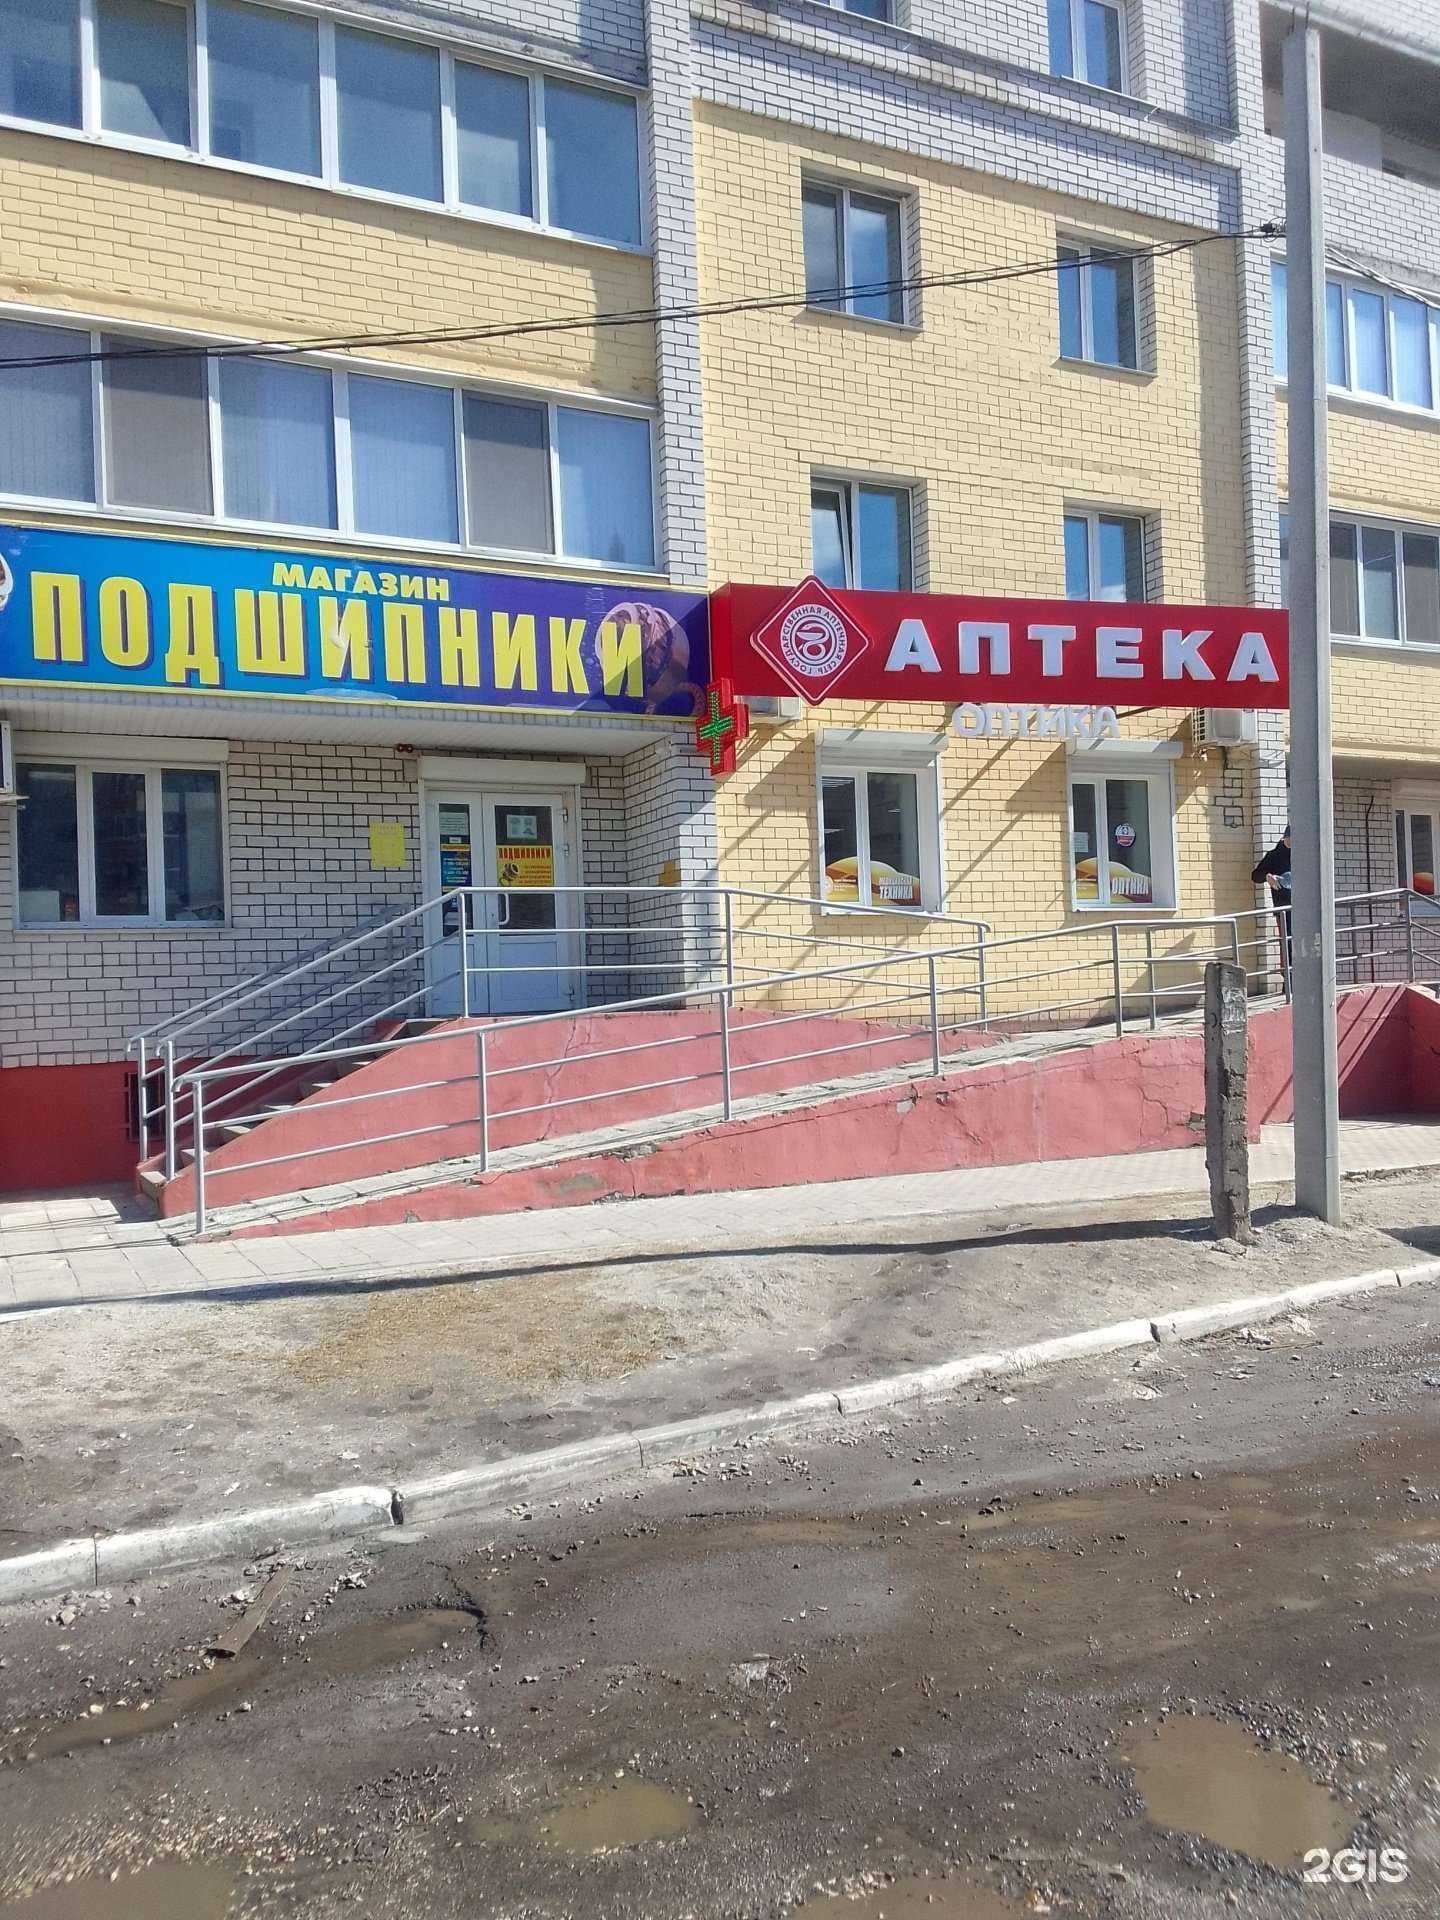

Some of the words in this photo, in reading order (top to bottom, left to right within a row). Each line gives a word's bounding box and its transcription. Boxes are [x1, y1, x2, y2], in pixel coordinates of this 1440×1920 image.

[272, 561, 451, 602] МАГАЗИН
[30, 570, 645, 699] ПОДШИПНИКИ
[781, 606, 822, 675] ГОСУДАРСТВЕННАЯ
[823, 611, 846, 660] АПТЕЧНАЯ
[884, 618, 1280, 683] АПТЕКА
[816, 660, 838, 675] СЕТЬ
[952, 702, 1120, 738] ОПТИКА
[1111, 877, 1149, 895] ОПТИКА
